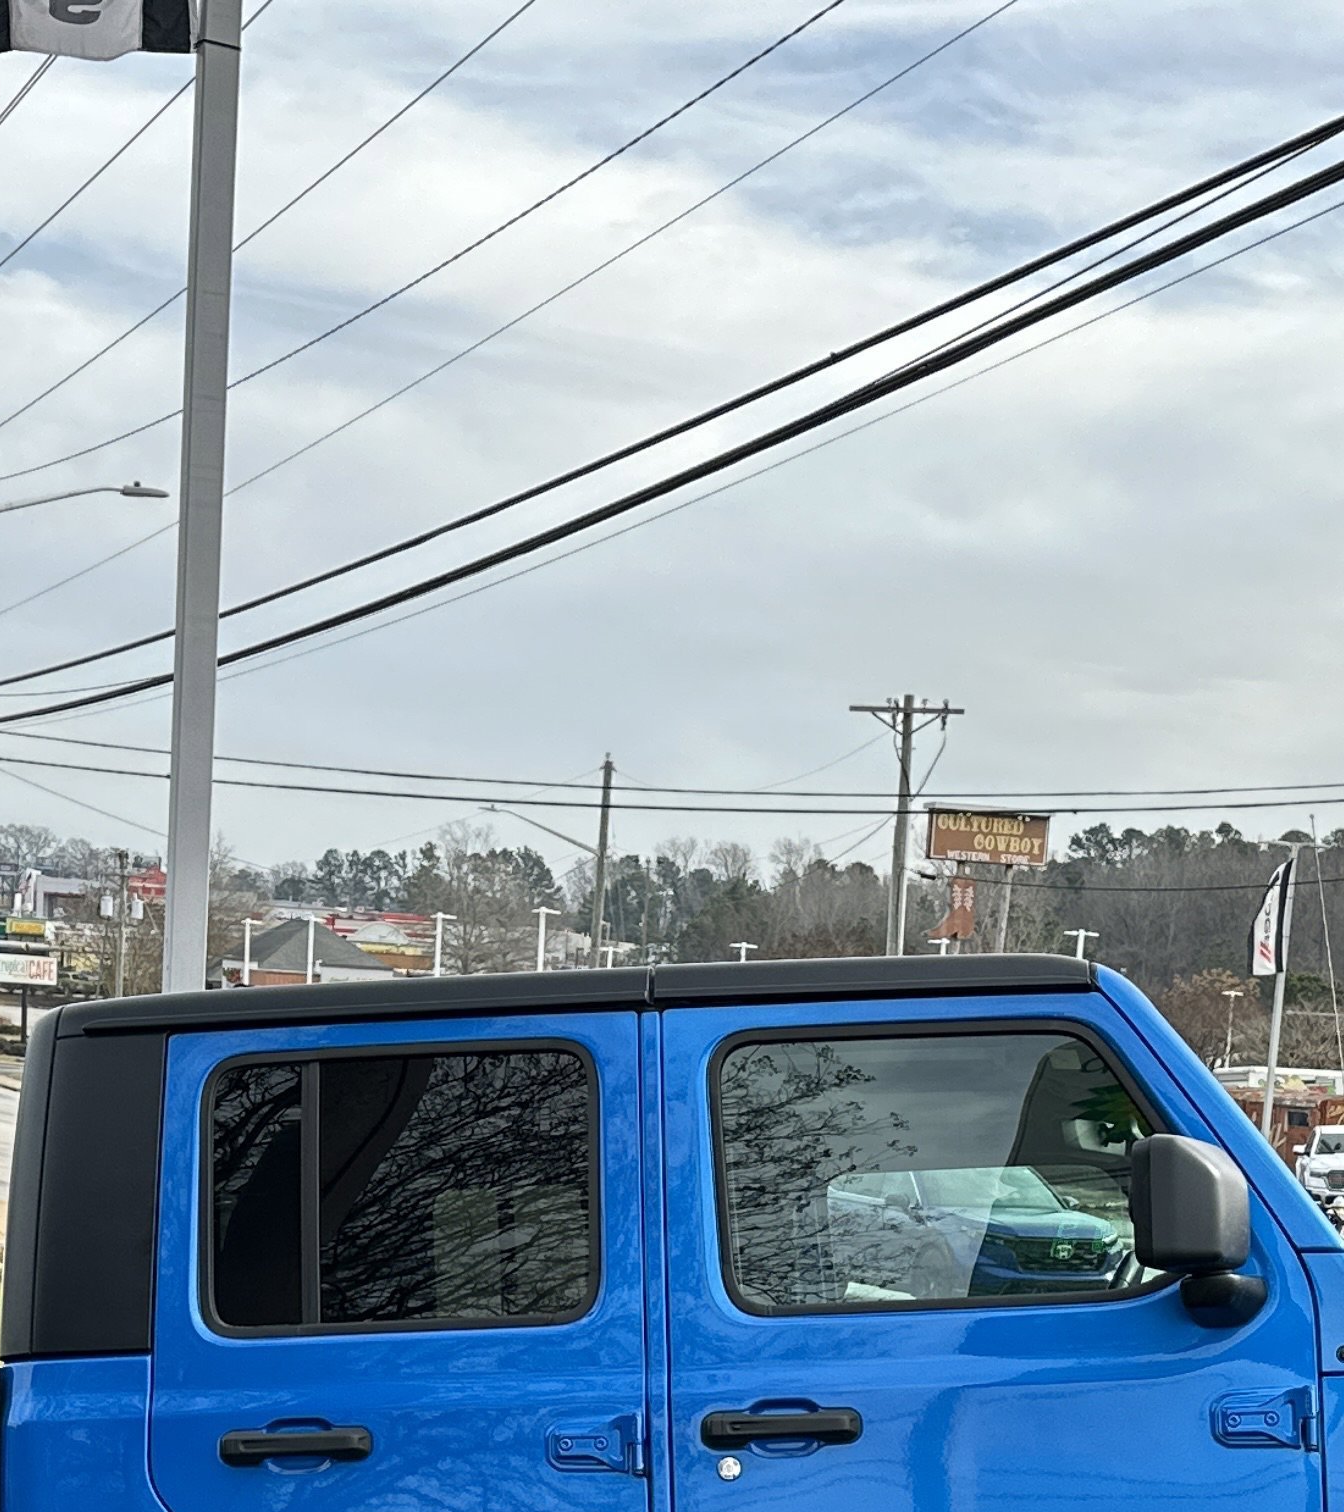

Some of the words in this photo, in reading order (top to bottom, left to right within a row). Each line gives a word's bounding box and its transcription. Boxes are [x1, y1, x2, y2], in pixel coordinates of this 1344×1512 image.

[937, 814, 1025, 835] CULTURED
[973, 834, 1044, 854] COWBOY
[946, 850, 991, 862] WESTERN
[1000, 854, 1031, 865] STORE
[28, 960, 55, 981] CAFE
